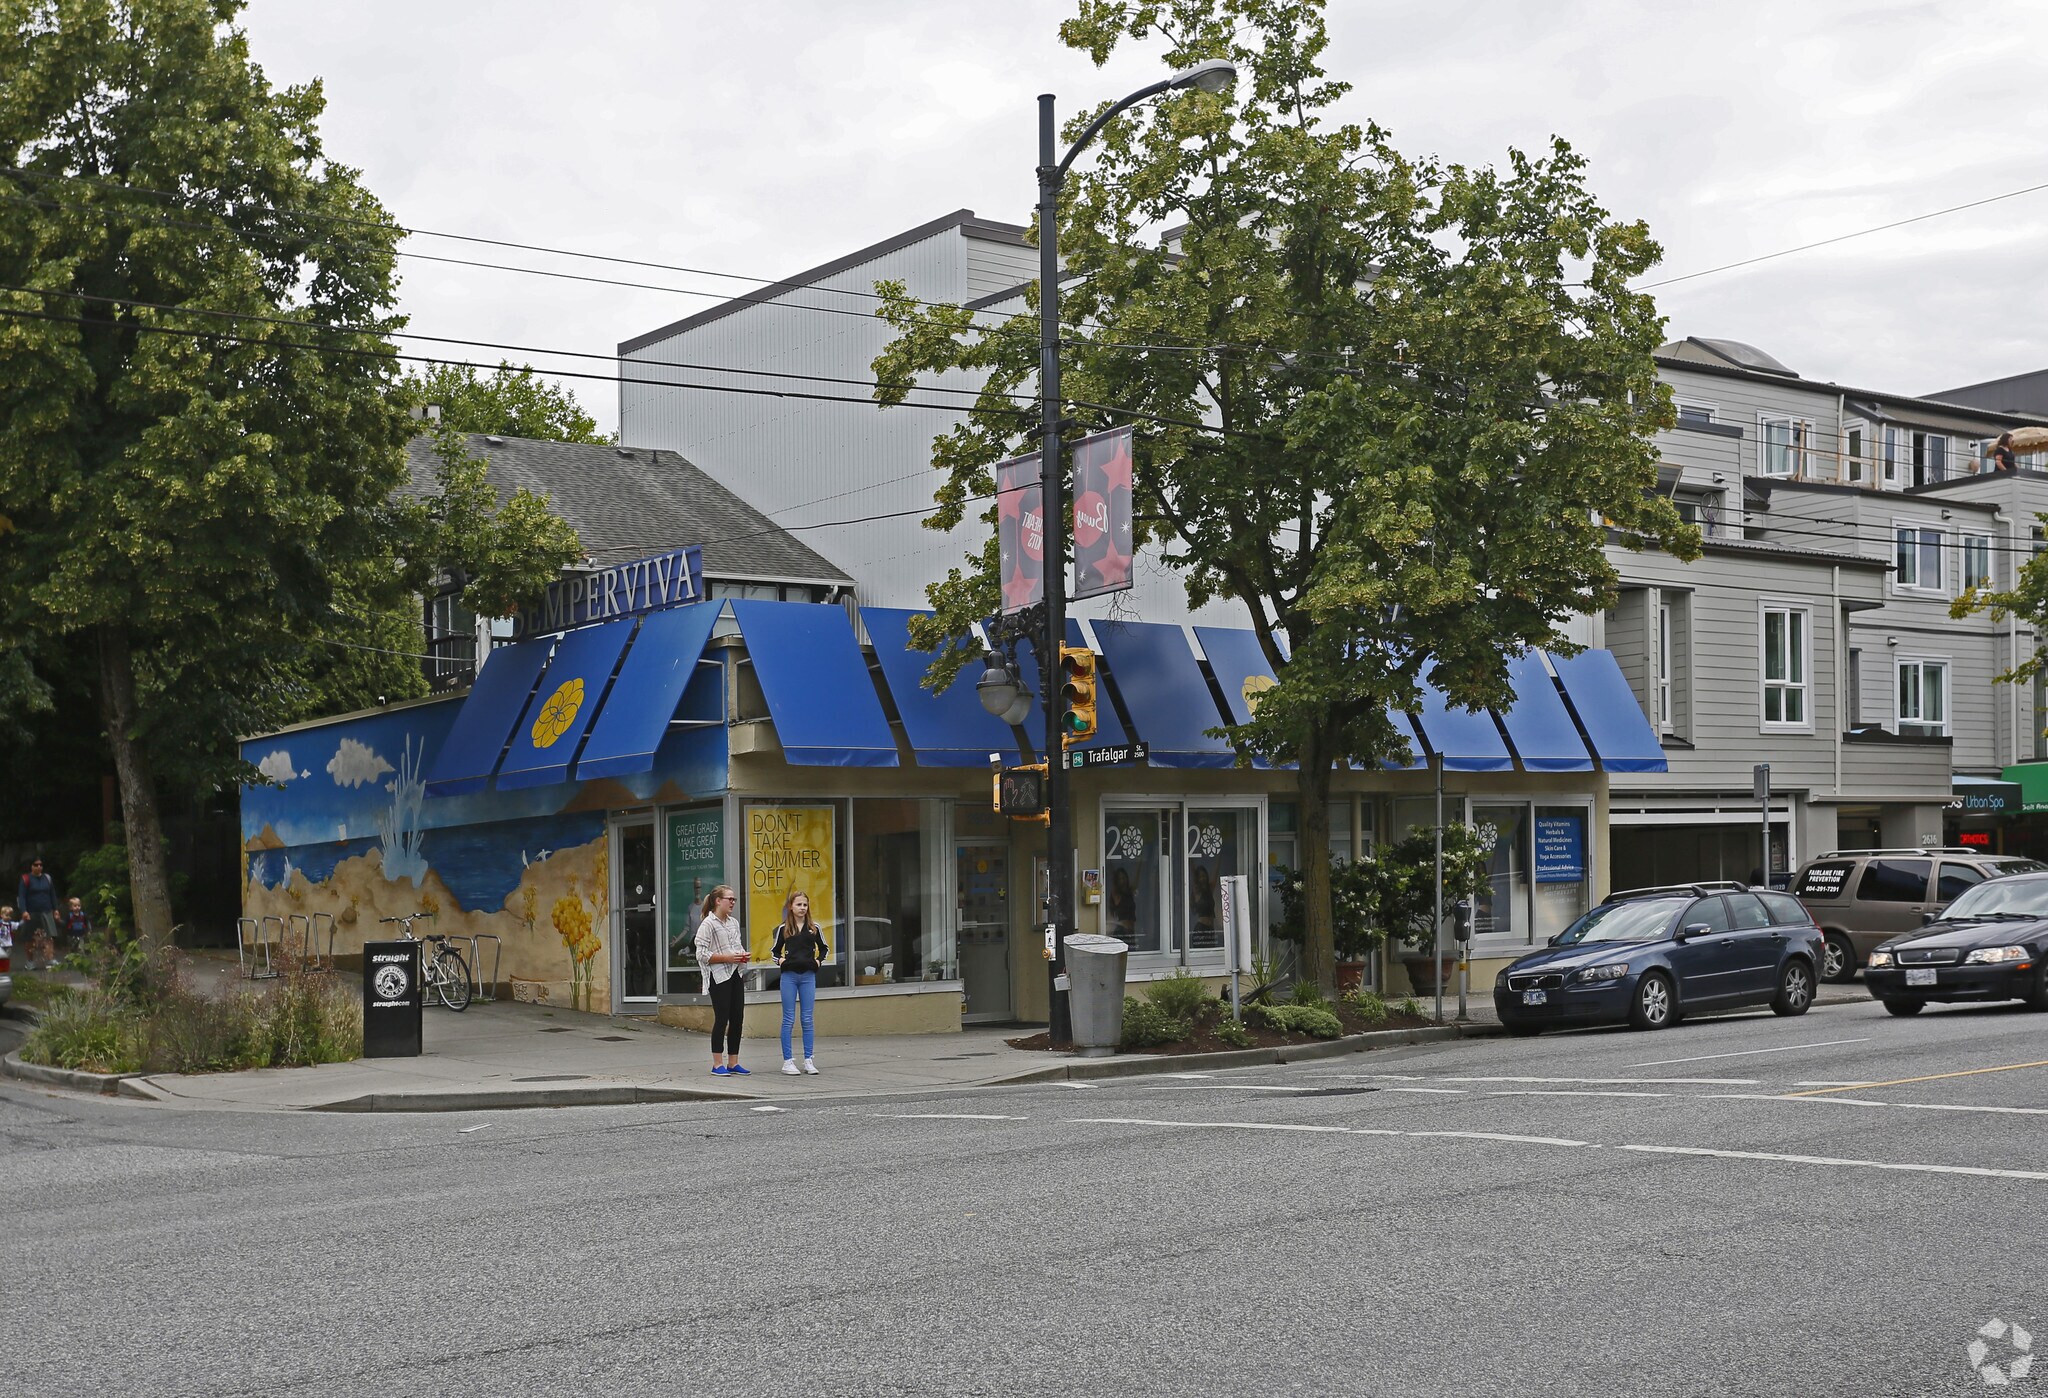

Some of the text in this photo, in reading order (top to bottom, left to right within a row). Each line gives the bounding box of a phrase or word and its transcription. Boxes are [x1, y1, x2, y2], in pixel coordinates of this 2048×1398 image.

[1088, 747, 1128, 763] Trafalgar
[1965, 795, 1989, 808] Urban
[1989, 794, 2004, 811] Spa
[675, 821, 719, 836] GREAT GRADS
[753, 814, 803, 832] DON'T
[677, 834, 717, 848] MAKE GREAT
[753, 832, 792, 850] TAKE
[1922, 834, 1937, 845] 2616
[681, 847, 714, 861] TEACHERS
[753, 850, 821, 869] SUMMER
[753, 868, 784, 888] OFF
[372, 954, 409, 962] straight
